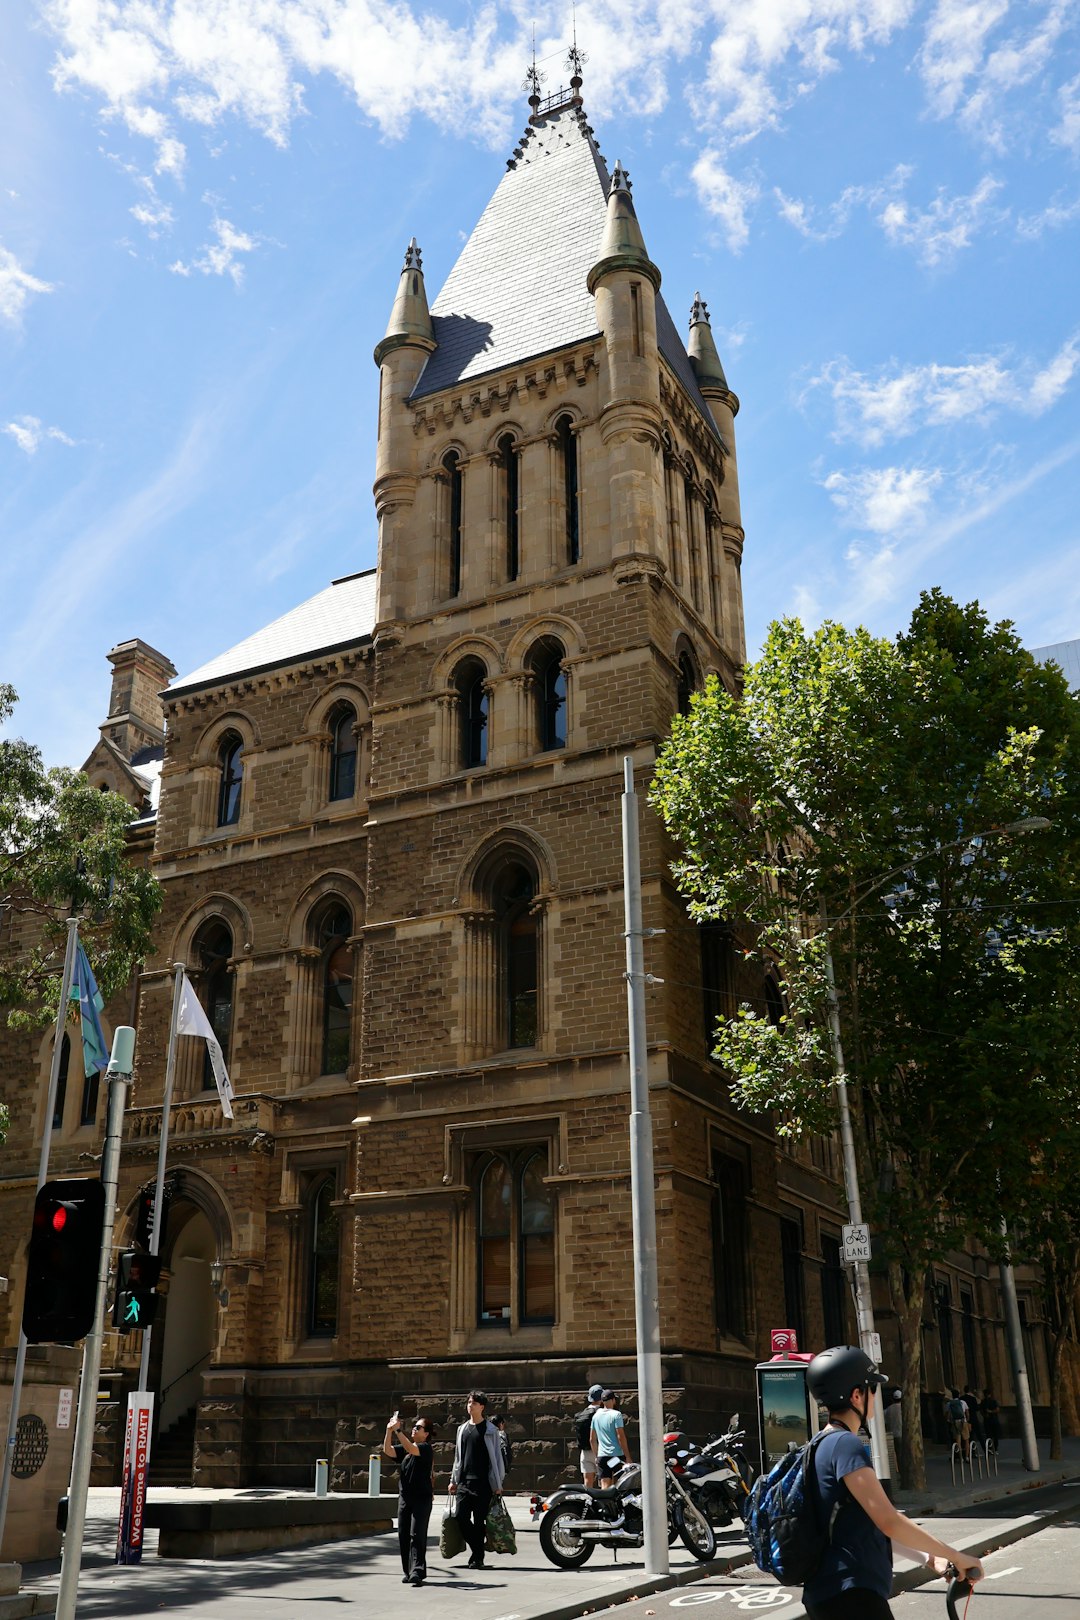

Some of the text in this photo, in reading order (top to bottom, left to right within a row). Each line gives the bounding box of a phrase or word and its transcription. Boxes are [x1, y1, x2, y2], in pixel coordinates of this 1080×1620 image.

[846, 1246, 869, 1257] LANE
[132, 1411, 149, 1543] Welcome to RMIT
